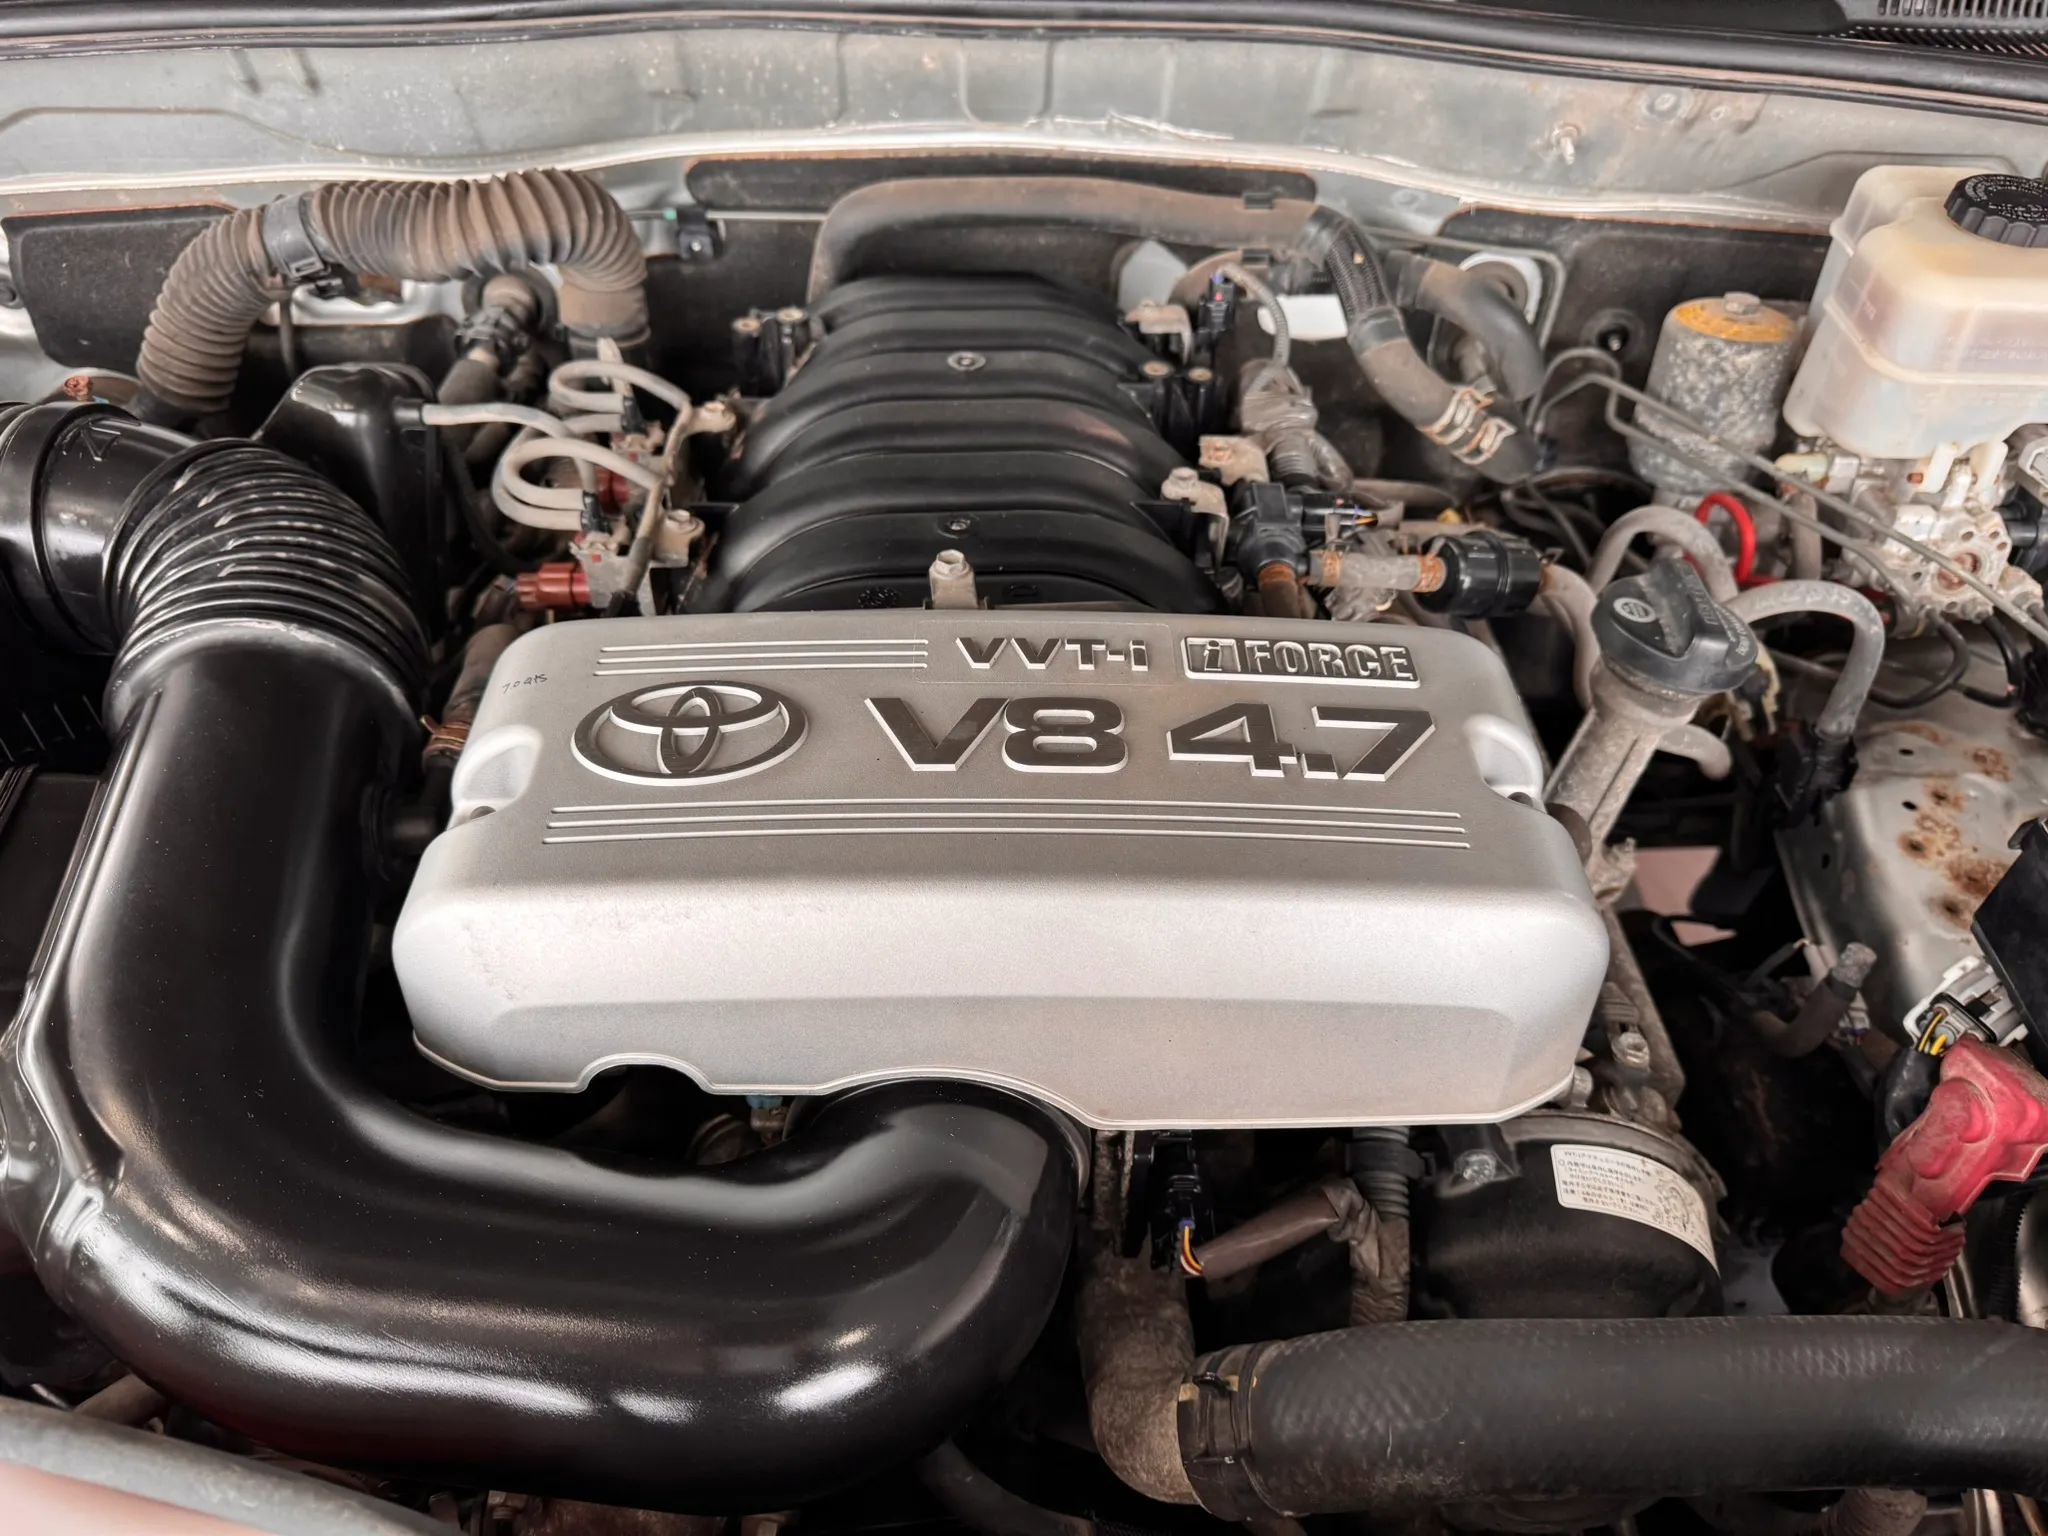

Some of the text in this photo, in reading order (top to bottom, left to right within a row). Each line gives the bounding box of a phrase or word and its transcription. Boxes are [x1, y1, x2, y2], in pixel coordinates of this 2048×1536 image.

[956, 637, 1149, 671] VVT-i
[1246, 640, 1413, 680] FORCE
[864, 697, 1436, 782] V8 4.7
